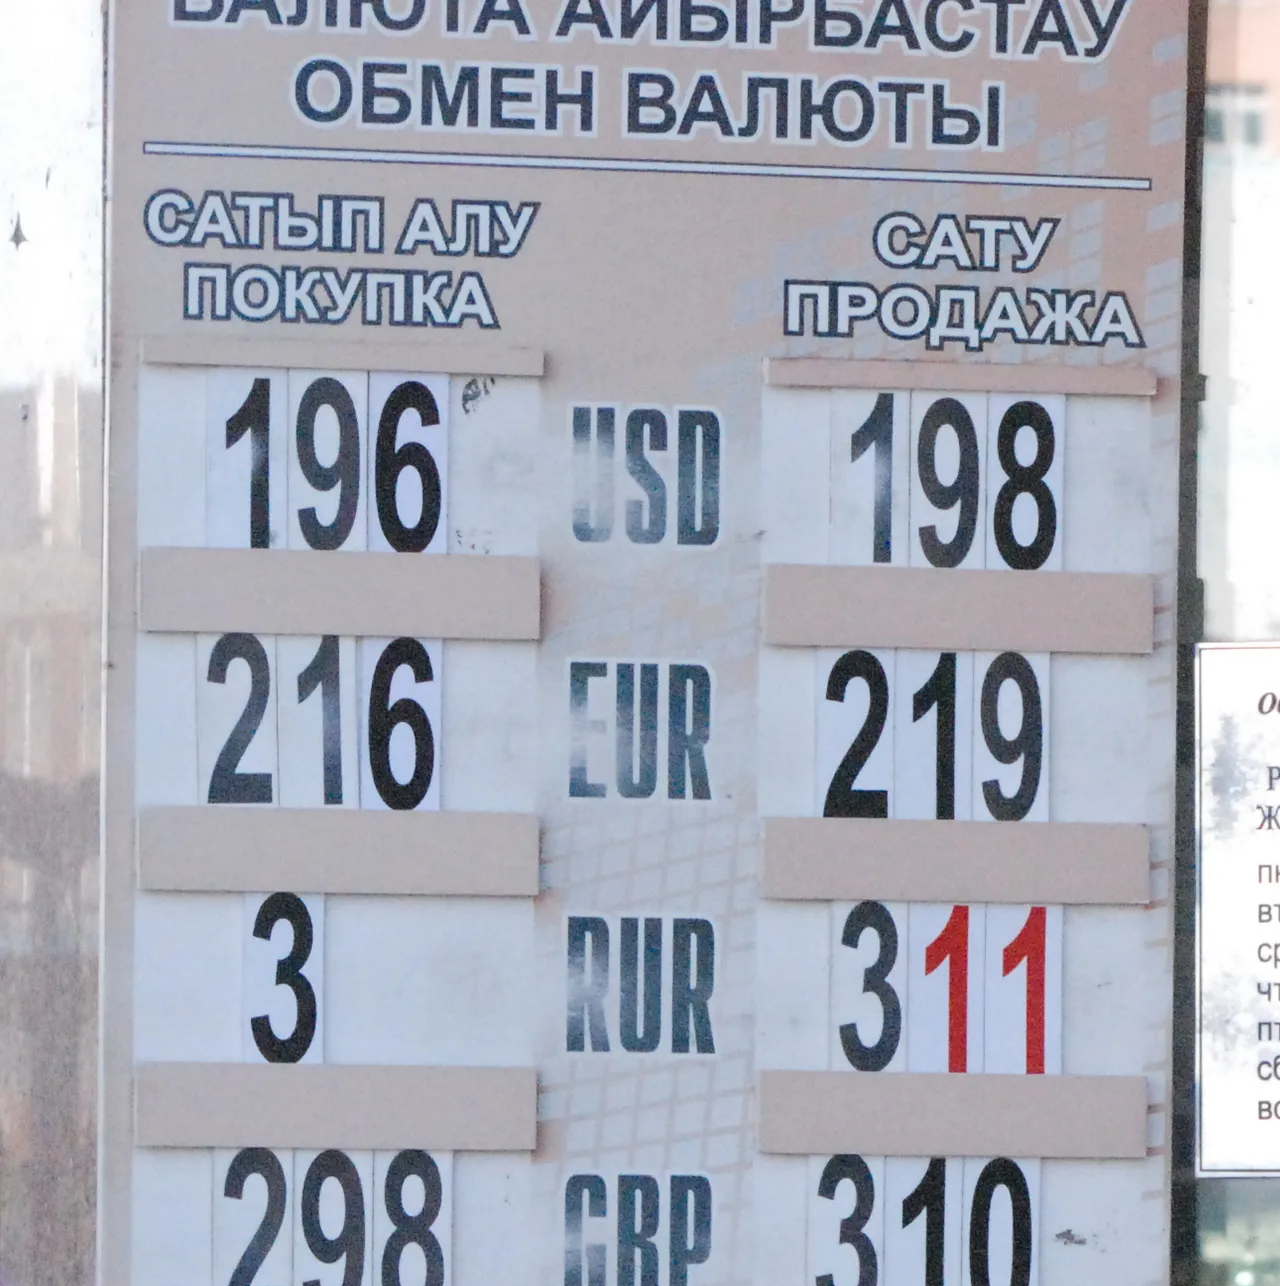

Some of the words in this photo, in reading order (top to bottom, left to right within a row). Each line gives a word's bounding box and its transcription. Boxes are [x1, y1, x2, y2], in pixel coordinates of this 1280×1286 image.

[293, 58, 595, 132] ОБМЕН
[626, 71, 1001, 147] ВАЛЮТЫ
[143, 188, 385, 254] САТЫП
[394, 198, 541, 259] АЛУ
[872, 210, 1062, 274] САТУ
[182, 260, 502, 330] ПОКУПКА
[783, 278, 1147, 352] ПРОДАЖА
[224, 376, 443, 555] 196
[571, 405, 722, 547] USD
[849, 392, 1058, 571] 198
[206, 631, 436, 812] 216
[568, 660, 713, 801] EUR
[821, 648, 1044, 824] 219
[249, 890, 319, 1065] 3
[565, 915, 717, 1055] RUR
[837, 899, 1048, 1076] 311
